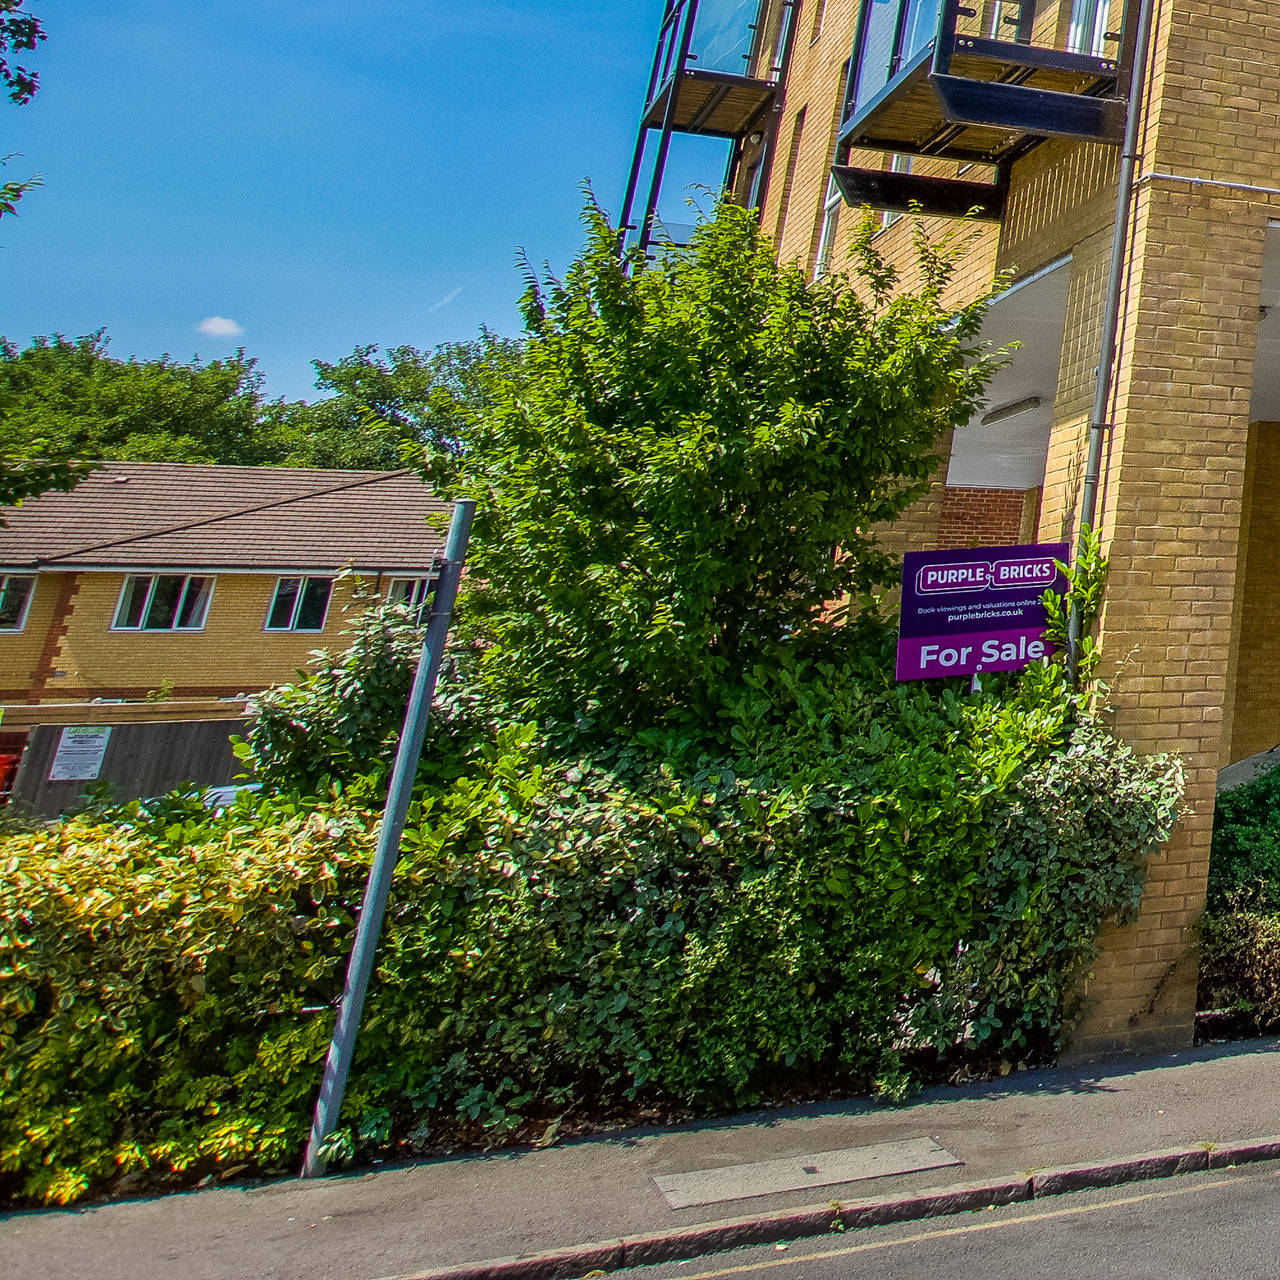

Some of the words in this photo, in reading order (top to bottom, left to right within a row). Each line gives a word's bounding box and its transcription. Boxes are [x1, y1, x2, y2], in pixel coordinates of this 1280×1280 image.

[927, 568, 984, 584] PURPLE
[1000, 564, 1050, 580] BRICKS
[936, 605, 967, 614] viewings
[982, 600, 1016, 609] valuations
[948, 608, 1024, 622] purplebricks.co.uk
[920, 645, 972, 669] For
[981, 636, 1045, 663] Sale
